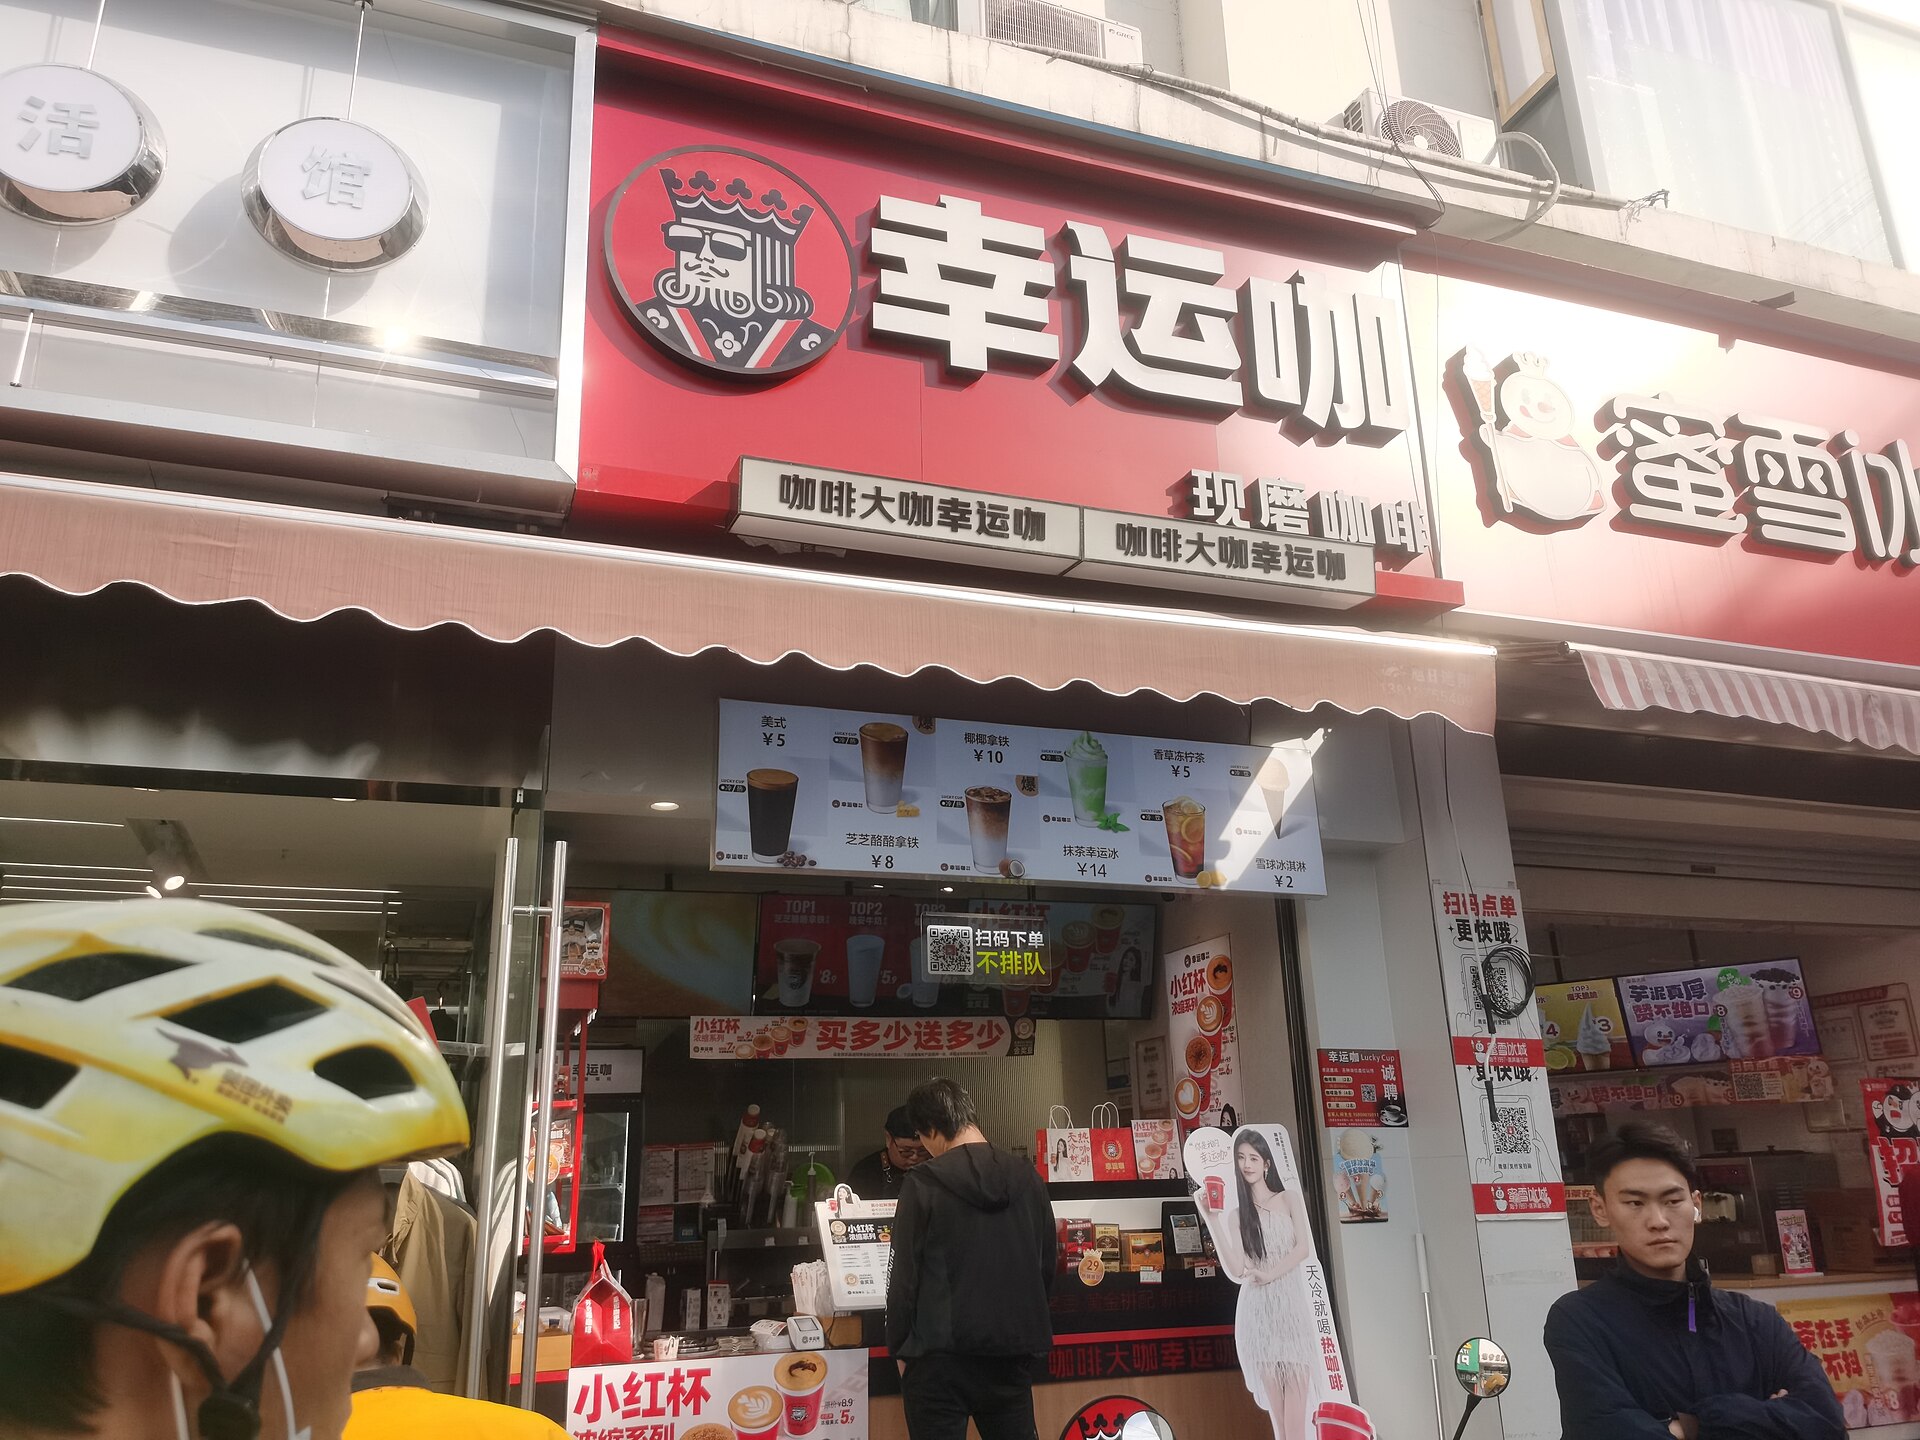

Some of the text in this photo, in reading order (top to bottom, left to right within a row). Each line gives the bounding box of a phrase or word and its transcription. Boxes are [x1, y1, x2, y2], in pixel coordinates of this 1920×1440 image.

[17, 94, 373, 210] 活 馆
[869, 194, 1411, 440] 幸运咖
[777, 472, 1048, 544] 咖啡大咖幸运咖
[1186, 468, 1432, 556] 现磨咖啡
[1114, 521, 1348, 583] 咖啡大咖幸运咖
[761, 714, 787, 730] 美式
[762, 732, 786, 748] ¥5
[964, 732, 1010, 748] 椰椰拿铁
[973, 749, 1004, 764] ¥10
[1153, 748, 1206, 764] 香草冻柠茶
[1171, 765, 1191, 778] ¥5
[1021, 775, 1036, 792] 爆
[845, 833, 920, 849] 芝芝酪酪拿铁
[1062, 844, 1120, 860] 抹茶幸运冰
[871, 854, 894, 869] ¥8
[1076, 861, 1108, 878] ¥14
[1255, 857, 1307, 873] 雪球冰淇淋
[1274, 875, 1294, 889] ¥2
[785, 899, 816, 913] TOP1
[849, 901, 883, 915] TOP2
[1443, 892, 1518, 919] 扫码点单
[975, 928, 1045, 949] 扫码下单
[1455, 918, 1512, 945] 更快哦
[976, 950, 1046, 976] 不排队
[1170, 967, 1206, 999] 小红杯
[1628, 977, 1707, 1003] 芋泥真厚
[1632, 1001, 1710, 1023] 赞不绝口
[694, 1017, 741, 1035] 小红杯
[816, 1018, 1006, 1052] 买多少送多少
[1328, 1050, 1396, 1063] 幸运咖 Lucky Cup
[1380, 1064, 1399, 1101] 诚聘
[1507, 1186, 1549, 1203] 蜜雪冰城
[848, 1224, 875, 1233] 小红杯
[1086, 1259, 1100, 1271] 29
[1200, 1268, 1208, 1276] 39
[1048, 1339, 1237, 1378] 咖啡大咖幸运咖
[573, 1367, 712, 1423] 小红杯
